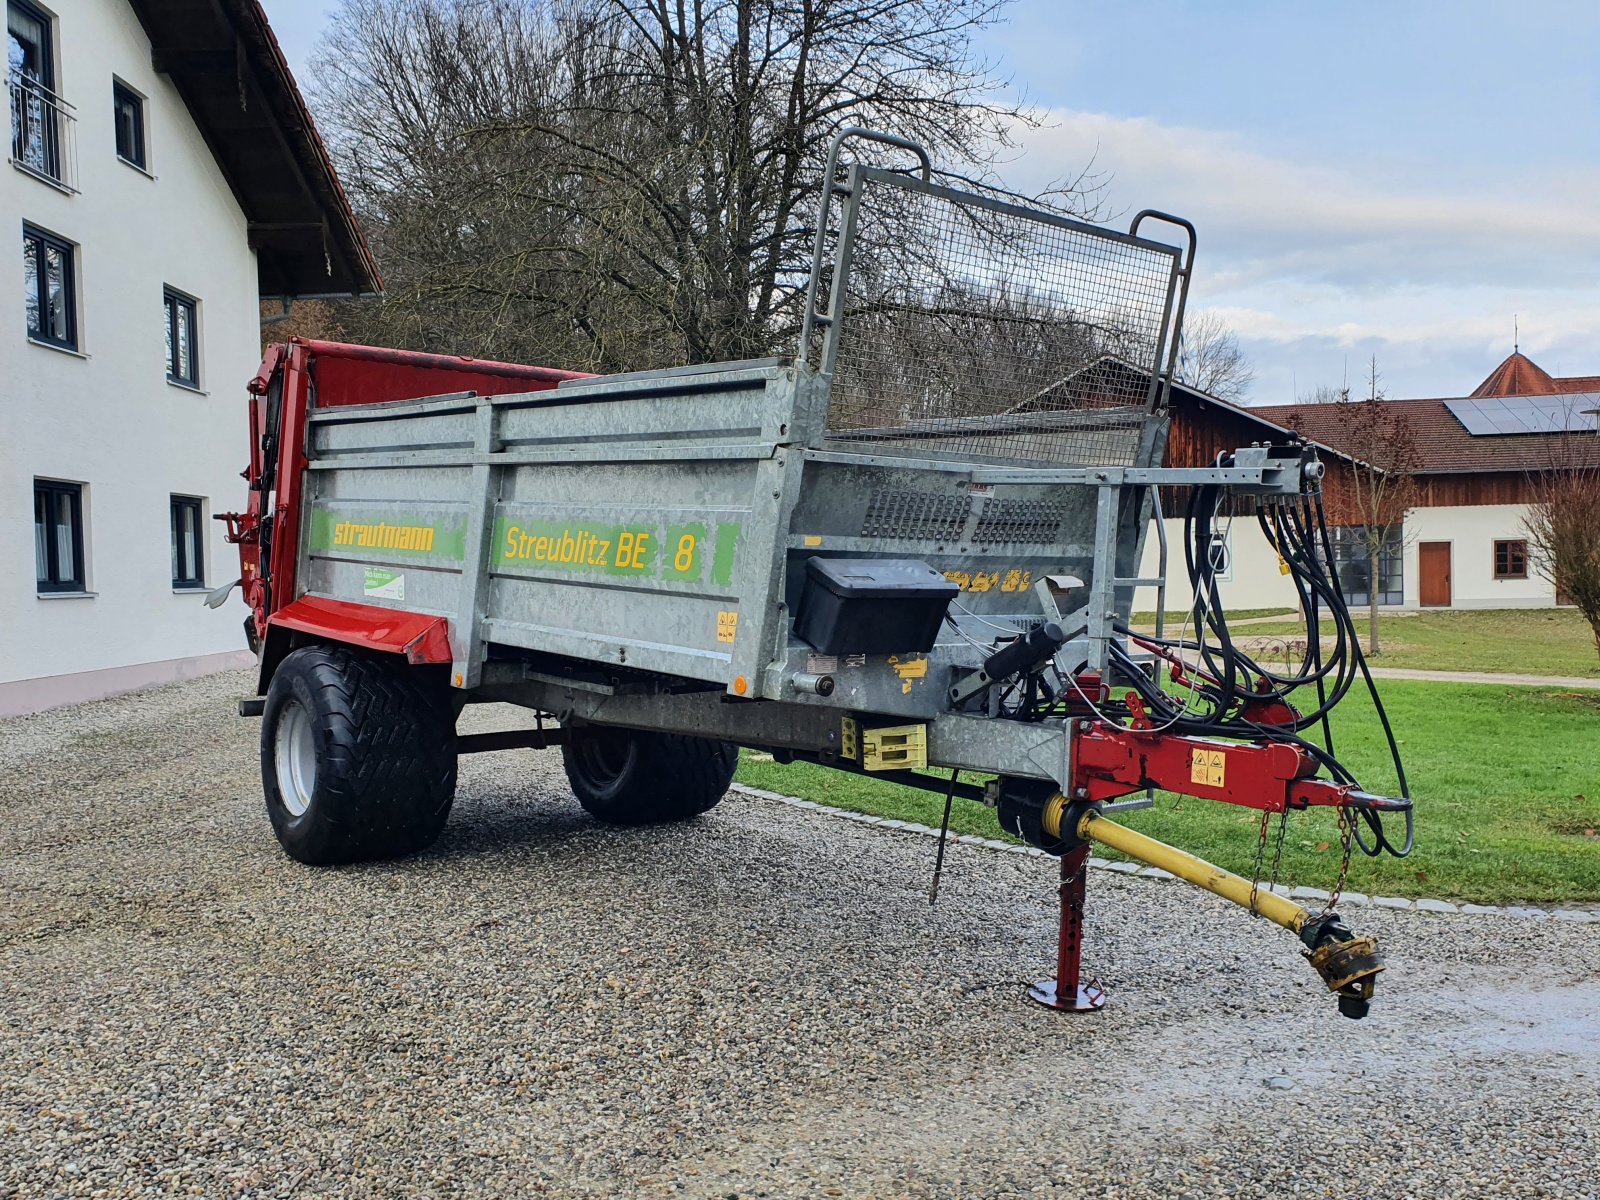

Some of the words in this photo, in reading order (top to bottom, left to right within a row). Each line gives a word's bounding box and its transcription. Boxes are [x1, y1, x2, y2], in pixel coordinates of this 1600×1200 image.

[334, 520, 435, 551] strautmann
[505, 526, 610, 566] Streublitz
[615, 532, 649, 569] BE
[674, 534, 695, 572] 8
